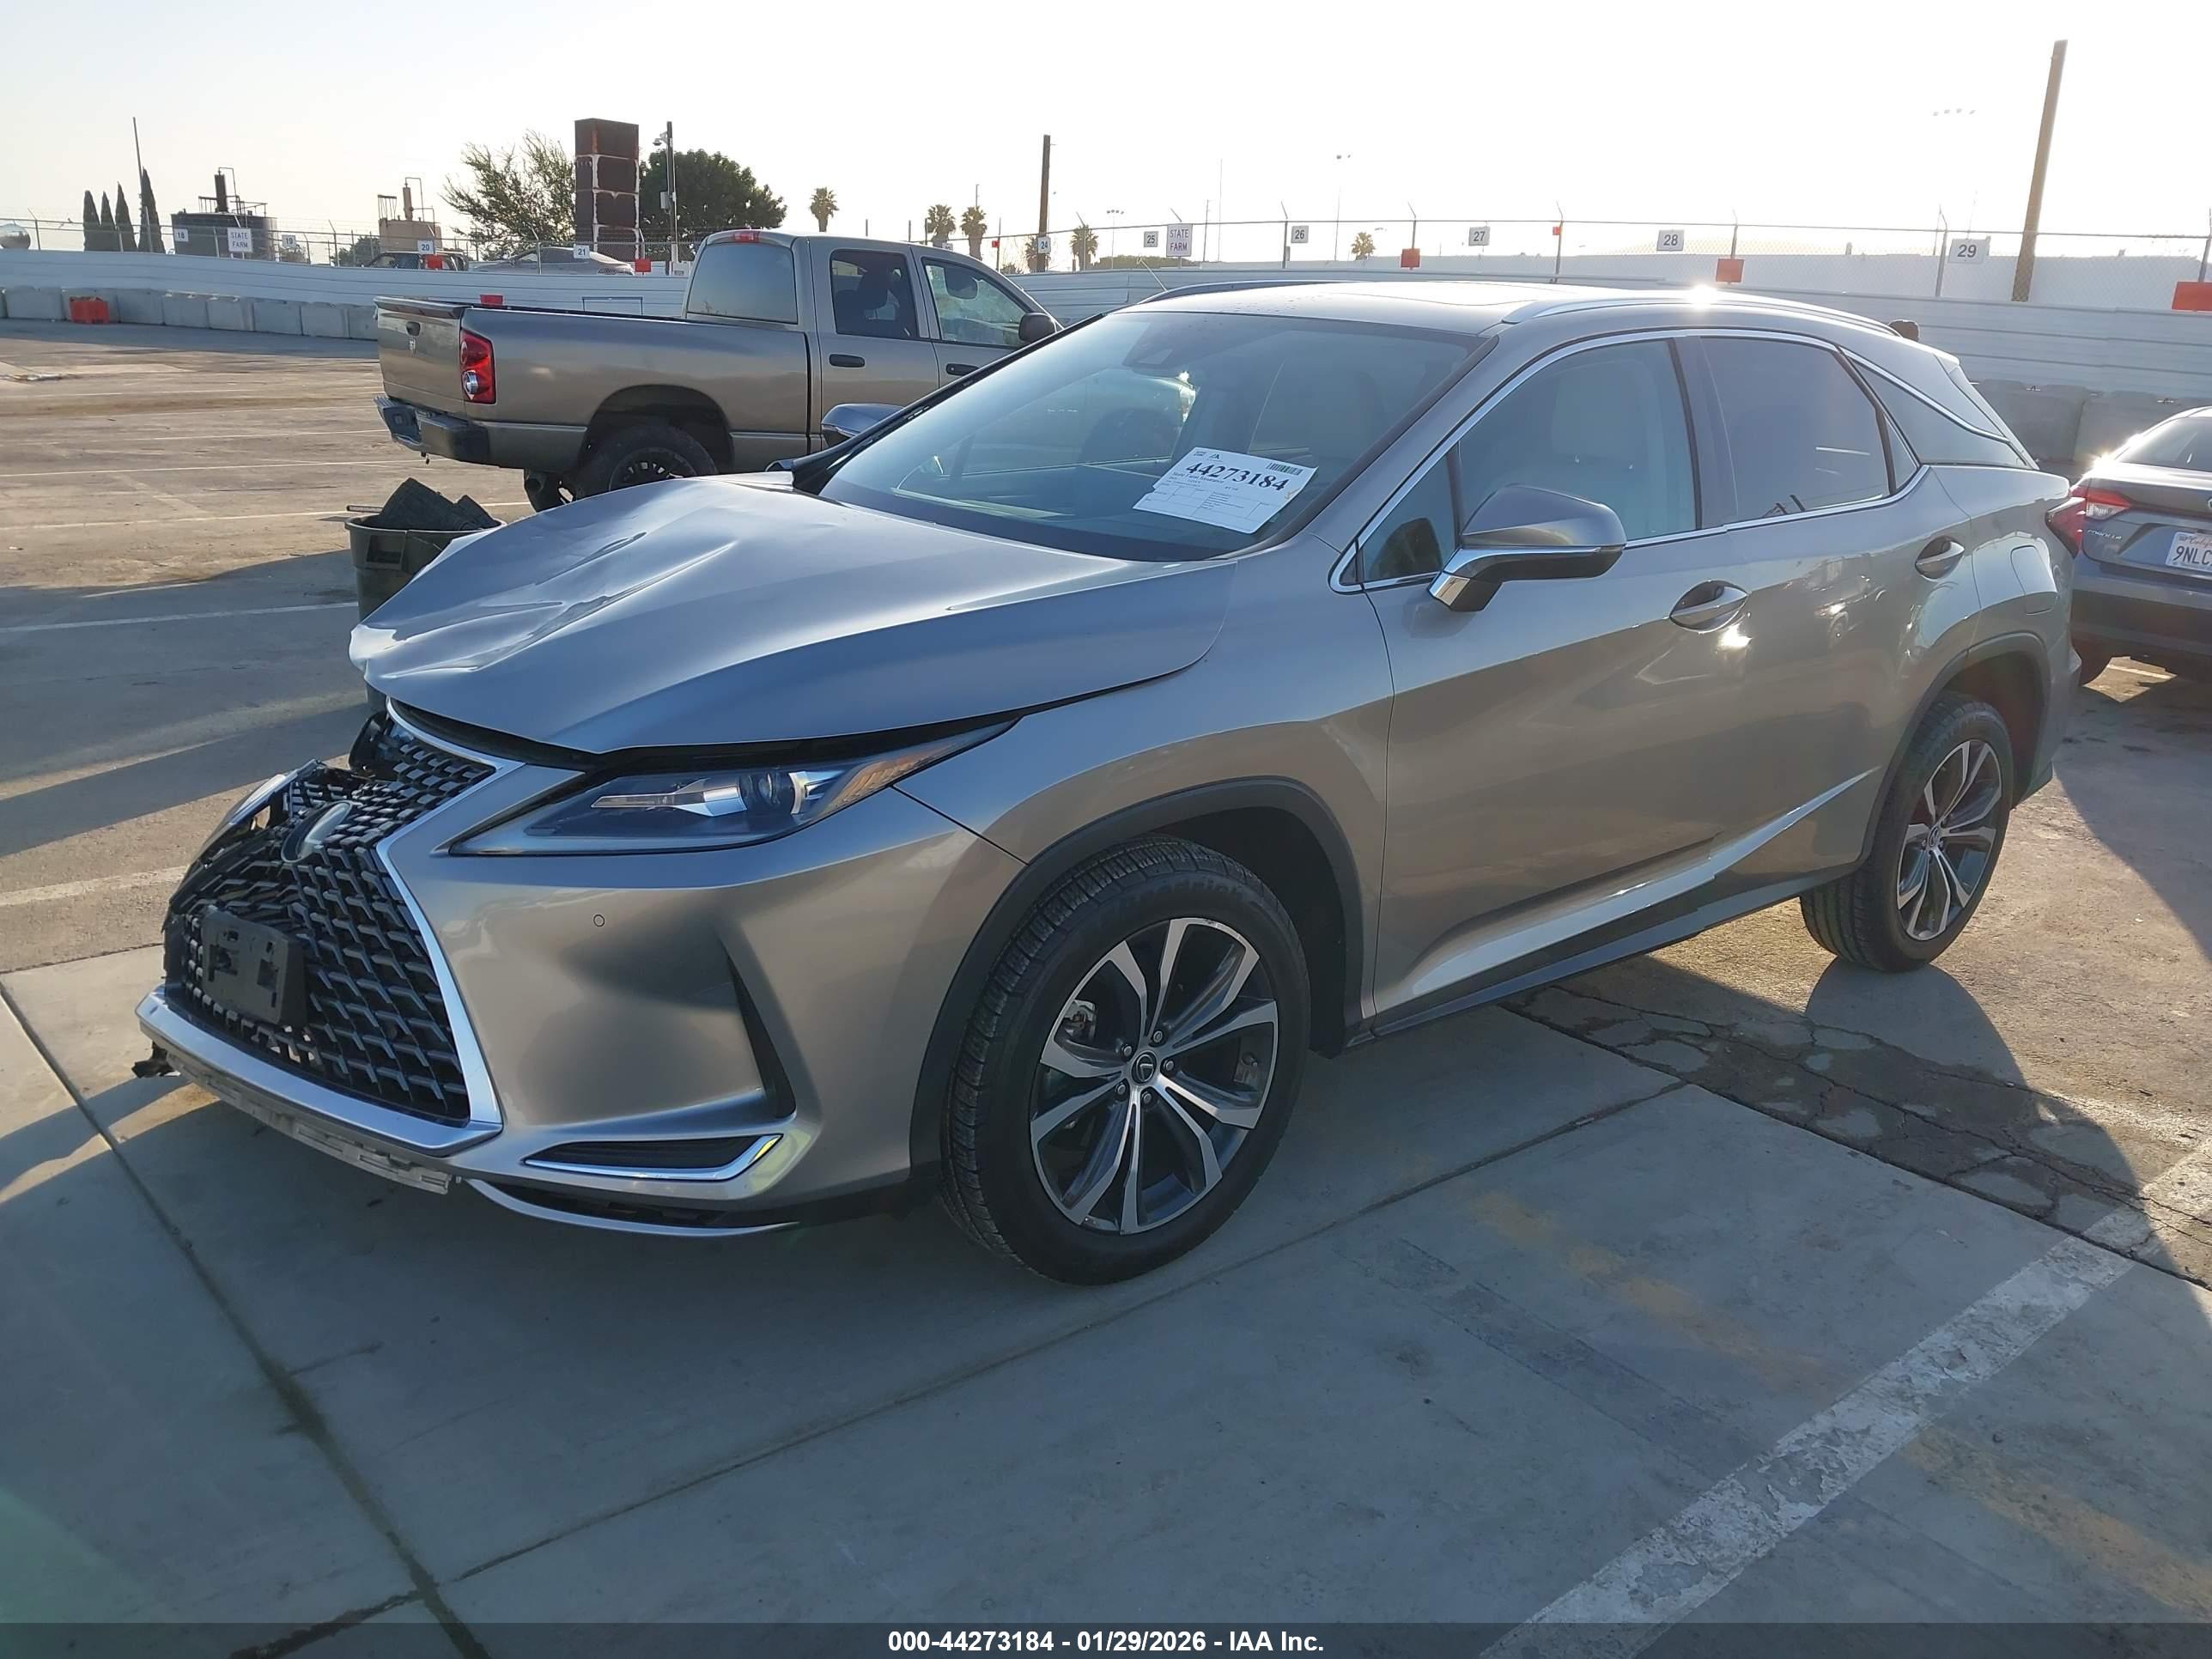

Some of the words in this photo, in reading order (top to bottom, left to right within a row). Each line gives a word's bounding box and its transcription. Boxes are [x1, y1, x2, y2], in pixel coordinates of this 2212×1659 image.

[177, 231, 185, 240] 18
[1146, 234, 1156, 244] 25
[1170, 228, 1189, 239] STATE
[1294, 229, 1305, 240] 26
[1473, 230, 1486, 241] 27
[1041, 240, 1048, 250] 24
[1662, 234, 1679, 246] 28
[1170, 241, 1188, 252] FARM
[1957, 244, 1978, 258] 29
[1186, 462, 1289, 491] 44273184
[2172, 545, 2212, 566] 9NLC
